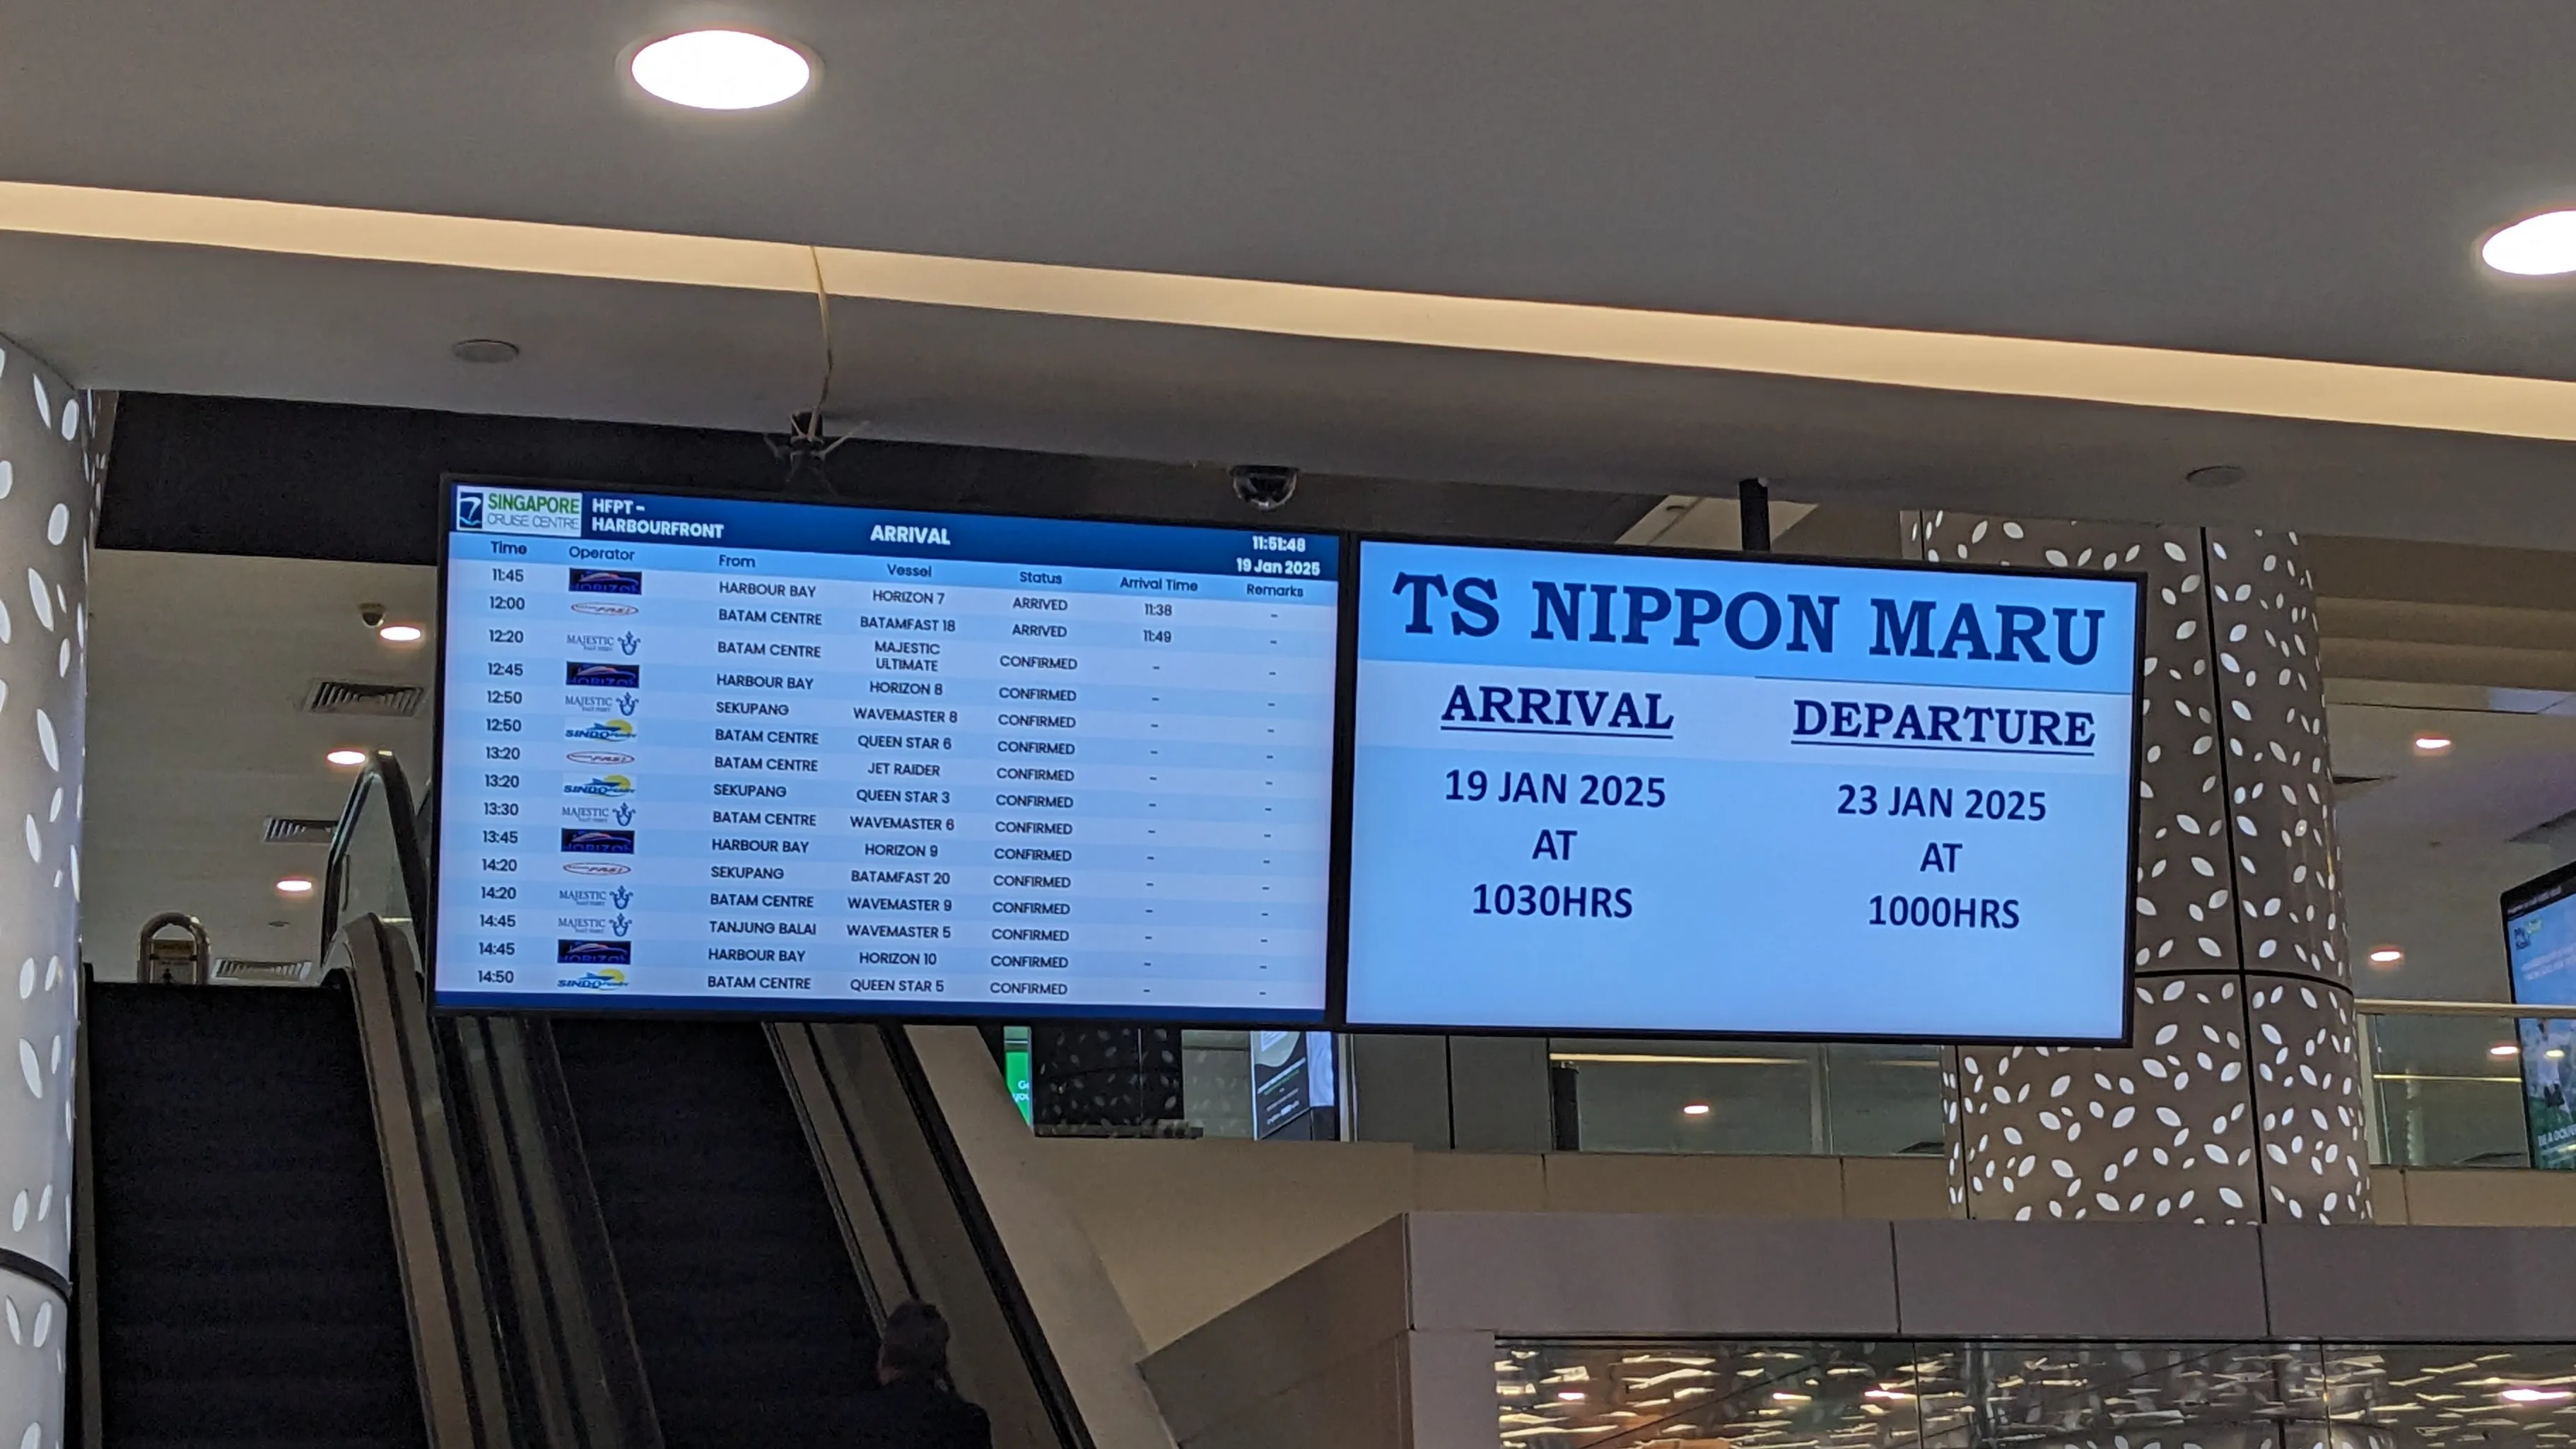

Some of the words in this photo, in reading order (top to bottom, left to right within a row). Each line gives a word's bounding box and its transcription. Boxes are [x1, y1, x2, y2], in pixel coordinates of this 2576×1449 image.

[488, 493, 580, 515] SINGAPORE
[592, 498, 633, 514] HFPT
[487, 513, 529, 527] CRUISE
[532, 515, 579, 530] CENTRE
[592, 517, 725, 539] HARBOURFRONT
[870, 524, 951, 546] ARRIVAL
[491, 540, 527, 556] Time
[1252, 535, 1306, 553] 11:51:48
[569, 546, 635, 561] Operator
[719, 554, 755, 568] From
[1236, 557, 1252, 573] 19
[1254, 558, 1282, 574] Jan
[1284, 560, 1321, 576] 2025
[492, 568, 524, 582] 11:45
[887, 563, 932, 577] Vessel
[1019, 572, 1062, 585] Status
[1120, 577, 1163, 591] Arrival
[1166, 579, 1198, 592] Time
[720, 581, 785, 597] HARBOUR
[790, 585, 816, 598] BAY
[873, 589, 933, 604] HORIZON
[937, 592, 944, 604] 7
[1247, 583, 1304, 598] Remarks
[490, 596, 525, 610] 12:00
[1012, 597, 1067, 611] ARRIVED
[1144, 603, 1172, 616] 11:38
[719, 609, 766, 623] BATAM
[771, 611, 822, 626] CENTRE
[860, 616, 939, 631] BATAMFAST
[942, 619, 956, 632] 18
[1393, 572, 1499, 638] TS
[1530, 581, 1841, 653] NIPPON
[1868, 597, 2106, 666] MARU
[489, 629, 524, 643] 12:20
[1012, 623, 1067, 638] ARRIVED
[1143, 630, 1171, 643] 11:49
[567, 634, 614, 645] MAJESTIC
[718, 641, 766, 655] BATAM
[769, 644, 821, 658] CENTRE
[874, 640, 940, 655] MAJESTIC
[488, 662, 523, 676] 12:45
[876, 657, 938, 672] ULTIMATE
[1000, 655, 1077, 670] CONFIRMED
[717, 674, 783, 688] HARBOUR
[787, 676, 814, 690] BAY
[870, 681, 930, 696] HORIZON
[934, 683, 943, 696] 8
[487, 691, 522, 704] 12:50
[566, 695, 612, 706] MAJESTIC
[999, 687, 1077, 701] CONFIRMED
[716, 701, 789, 716] SEKUPANG
[1441, 684, 1675, 729] ARRIVAL
[853, 707, 945, 723] WAVEMASTER
[949, 710, 957, 723] 8
[998, 714, 1076, 728] CONFIRMED
[486, 718, 522, 732] 12:50
[1793, 699, 2095, 747] DEPARTURE
[715, 729, 763, 742] BATAM
[767, 731, 819, 744] CENTRE
[857, 735, 902, 749] QUEEN
[906, 737, 939, 750] STAR
[943, 737, 952, 750] 6
[486, 746, 520, 760] 13:20
[997, 741, 1075, 755] CONFIRMED
[715, 756, 763, 770] BATAM
[766, 758, 818, 772] CENTRE
[867, 762, 891, 775] JET
[894, 763, 940, 777] RAIDER
[485, 774, 520, 788] 13:20
[997, 768, 1075, 782] CONFIRMED
[713, 783, 787, 797] SEKUPANG
[1446, 769, 1487, 802] 19
[1498, 771, 1567, 804] JAN
[1580, 774, 1665, 808] 2025
[857, 789, 901, 803] QUEEN
[904, 791, 938, 804] STAR
[942, 791, 950, 804] 3
[996, 794, 1074, 809] CONFIRMED
[1837, 784, 1878, 816] 23
[1887, 786, 1953, 819] JAN
[1965, 789, 2046, 821] 2025
[484, 802, 519, 816] 13:30
[562, 806, 609, 818] MAJESTIC
[713, 811, 761, 824] BATAM
[764, 813, 816, 826] CENTRE
[850, 816, 942, 831] WAVEMASTER
[946, 819, 954, 831] 6
[995, 821, 1073, 835] CONFIRMED
[483, 830, 518, 844] 13:45
[712, 838, 779, 852] HARBOUR
[782, 840, 809, 853] BAY
[865, 843, 926, 857] HORIZON
[930, 845, 938, 857] 9
[1532, 829, 1578, 861] AT
[994, 848, 1072, 862] CONFIRMED
[1919, 842, 1963, 874] AT
[482, 859, 517, 872] 14:20
[711, 866, 784, 879] SEKUPANG
[851, 870, 930, 884] BATAMFAST
[933, 872, 950, 884] 20
[993, 874, 1071, 888] CONFIRMED
[481, 886, 516, 899] 14:20
[559, 890, 607, 901] MAJESTIC
[710, 893, 759, 906] BATAM
[762, 895, 814, 908] CENTRE
[848, 897, 940, 911] WAVEMASTER
[944, 899, 952, 912] 9
[1473, 884, 1632, 919] 1030HRS
[993, 902, 1070, 915] CONFIRMED
[1869, 895, 2020, 929] 1000HRS
[480, 914, 516, 927] 14:45
[558, 917, 606, 928] MAJESTIC
[709, 921, 775, 934] TANJUNG
[779, 922, 816, 935] BALAI
[847, 925, 939, 939] WAVEMASTER
[942, 926, 951, 938] 5
[992, 929, 1070, 941] CONFIRMED
[479, 942, 515, 956] 14:45
[708, 948, 775, 961] HARBOUR
[778, 950, 806, 962] BAY
[860, 952, 920, 966] HORIZON
[923, 953, 937, 966] 10
[991, 955, 1069, 968] CONFIRMED
[478, 970, 514, 983] 14:50
[708, 975, 756, 988] BATAM
[759, 977, 812, 990] CENTRE
[850, 979, 895, 992] QUEEN
[898, 980, 932, 992] STAR
[936, 980, 944, 992] 5
[990, 982, 1067, 995] CONFIRMED
